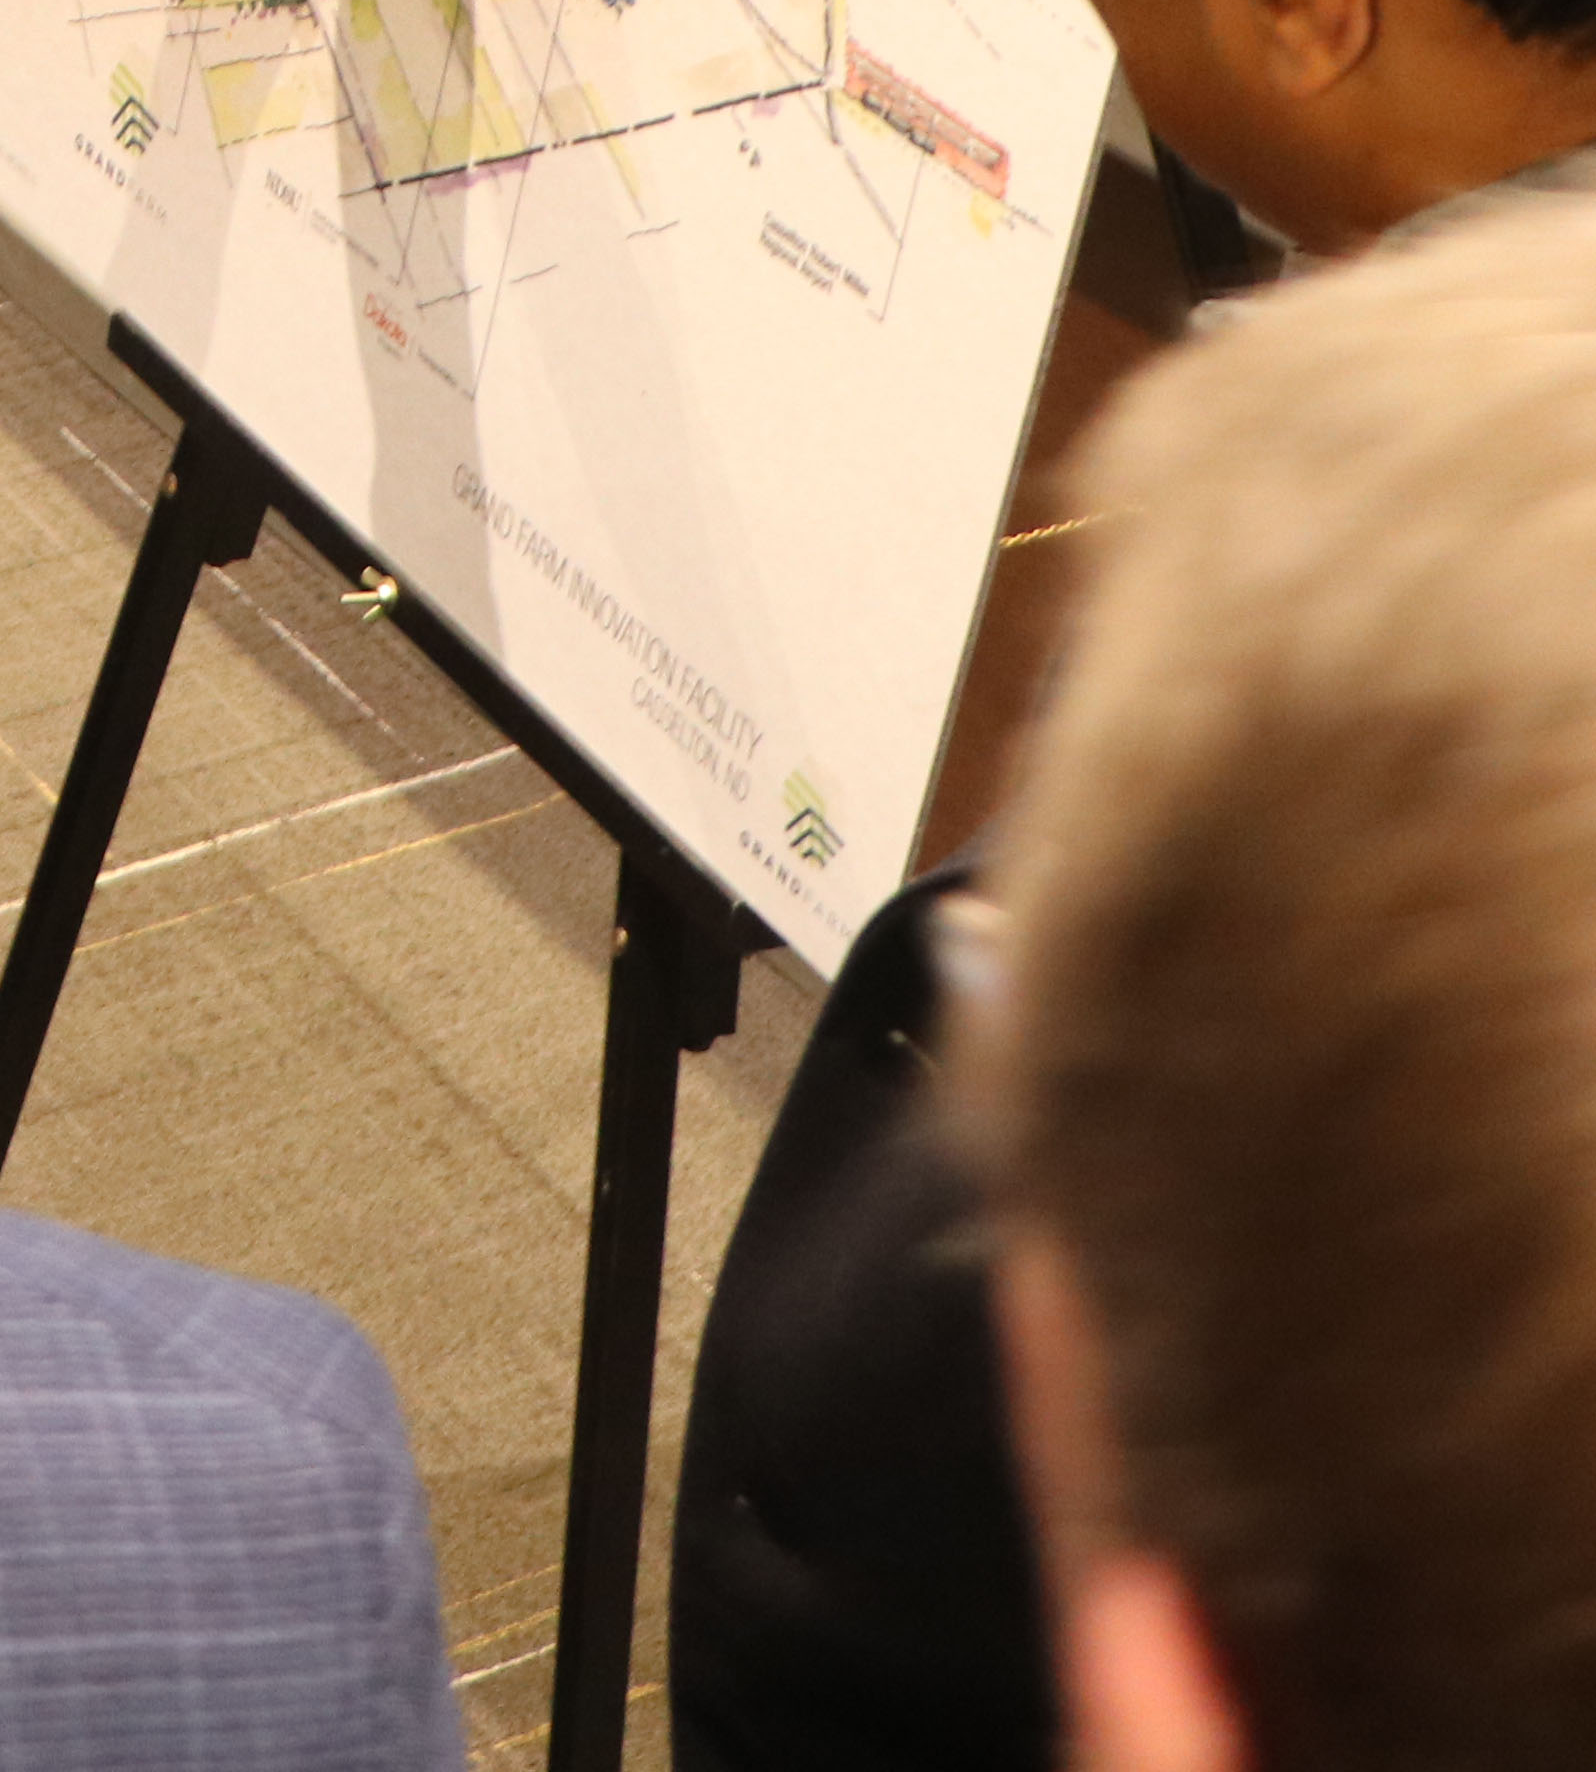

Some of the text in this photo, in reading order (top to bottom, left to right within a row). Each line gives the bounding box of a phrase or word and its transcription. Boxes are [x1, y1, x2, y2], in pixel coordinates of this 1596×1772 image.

[452, 462, 764, 760] GRAND FARM INNOVATION FACILITY
